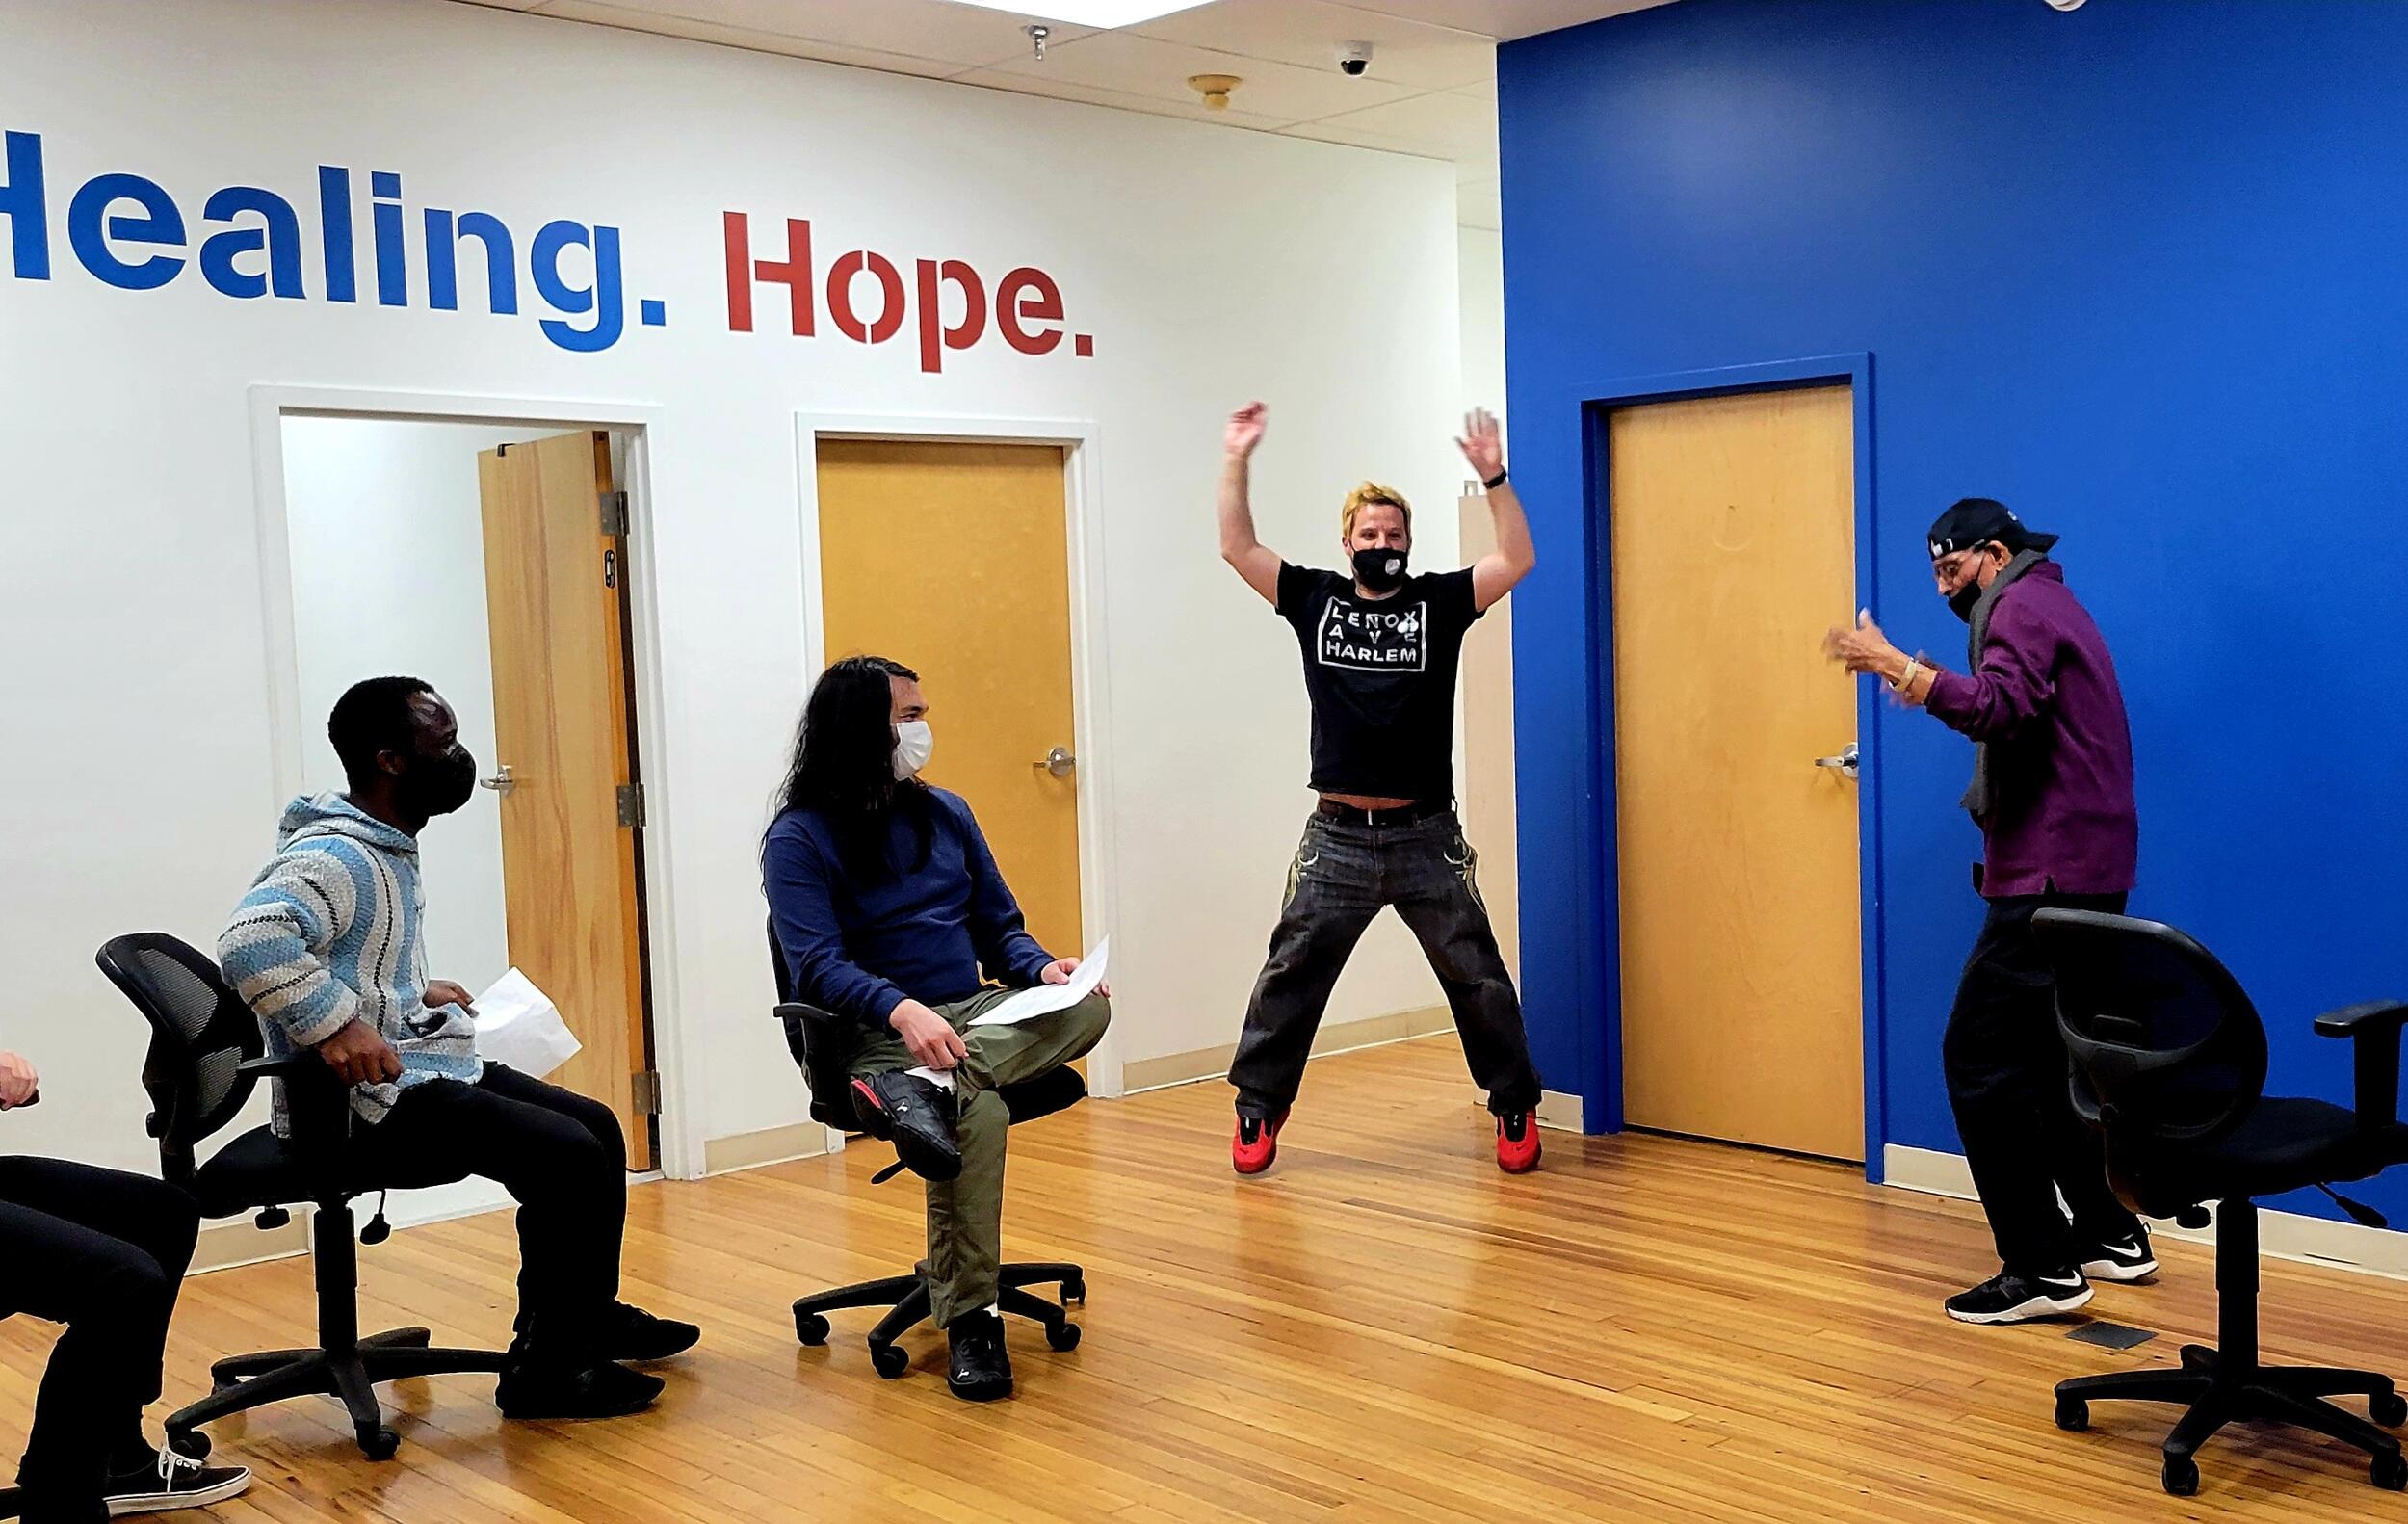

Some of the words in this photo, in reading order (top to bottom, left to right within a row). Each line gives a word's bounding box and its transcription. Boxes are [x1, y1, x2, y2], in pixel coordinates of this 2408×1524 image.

[723, 211, 1094, 373] Hope.
[1332, 605, 1416, 629] LENOX
[1326, 640, 1417, 662] HARLEM
